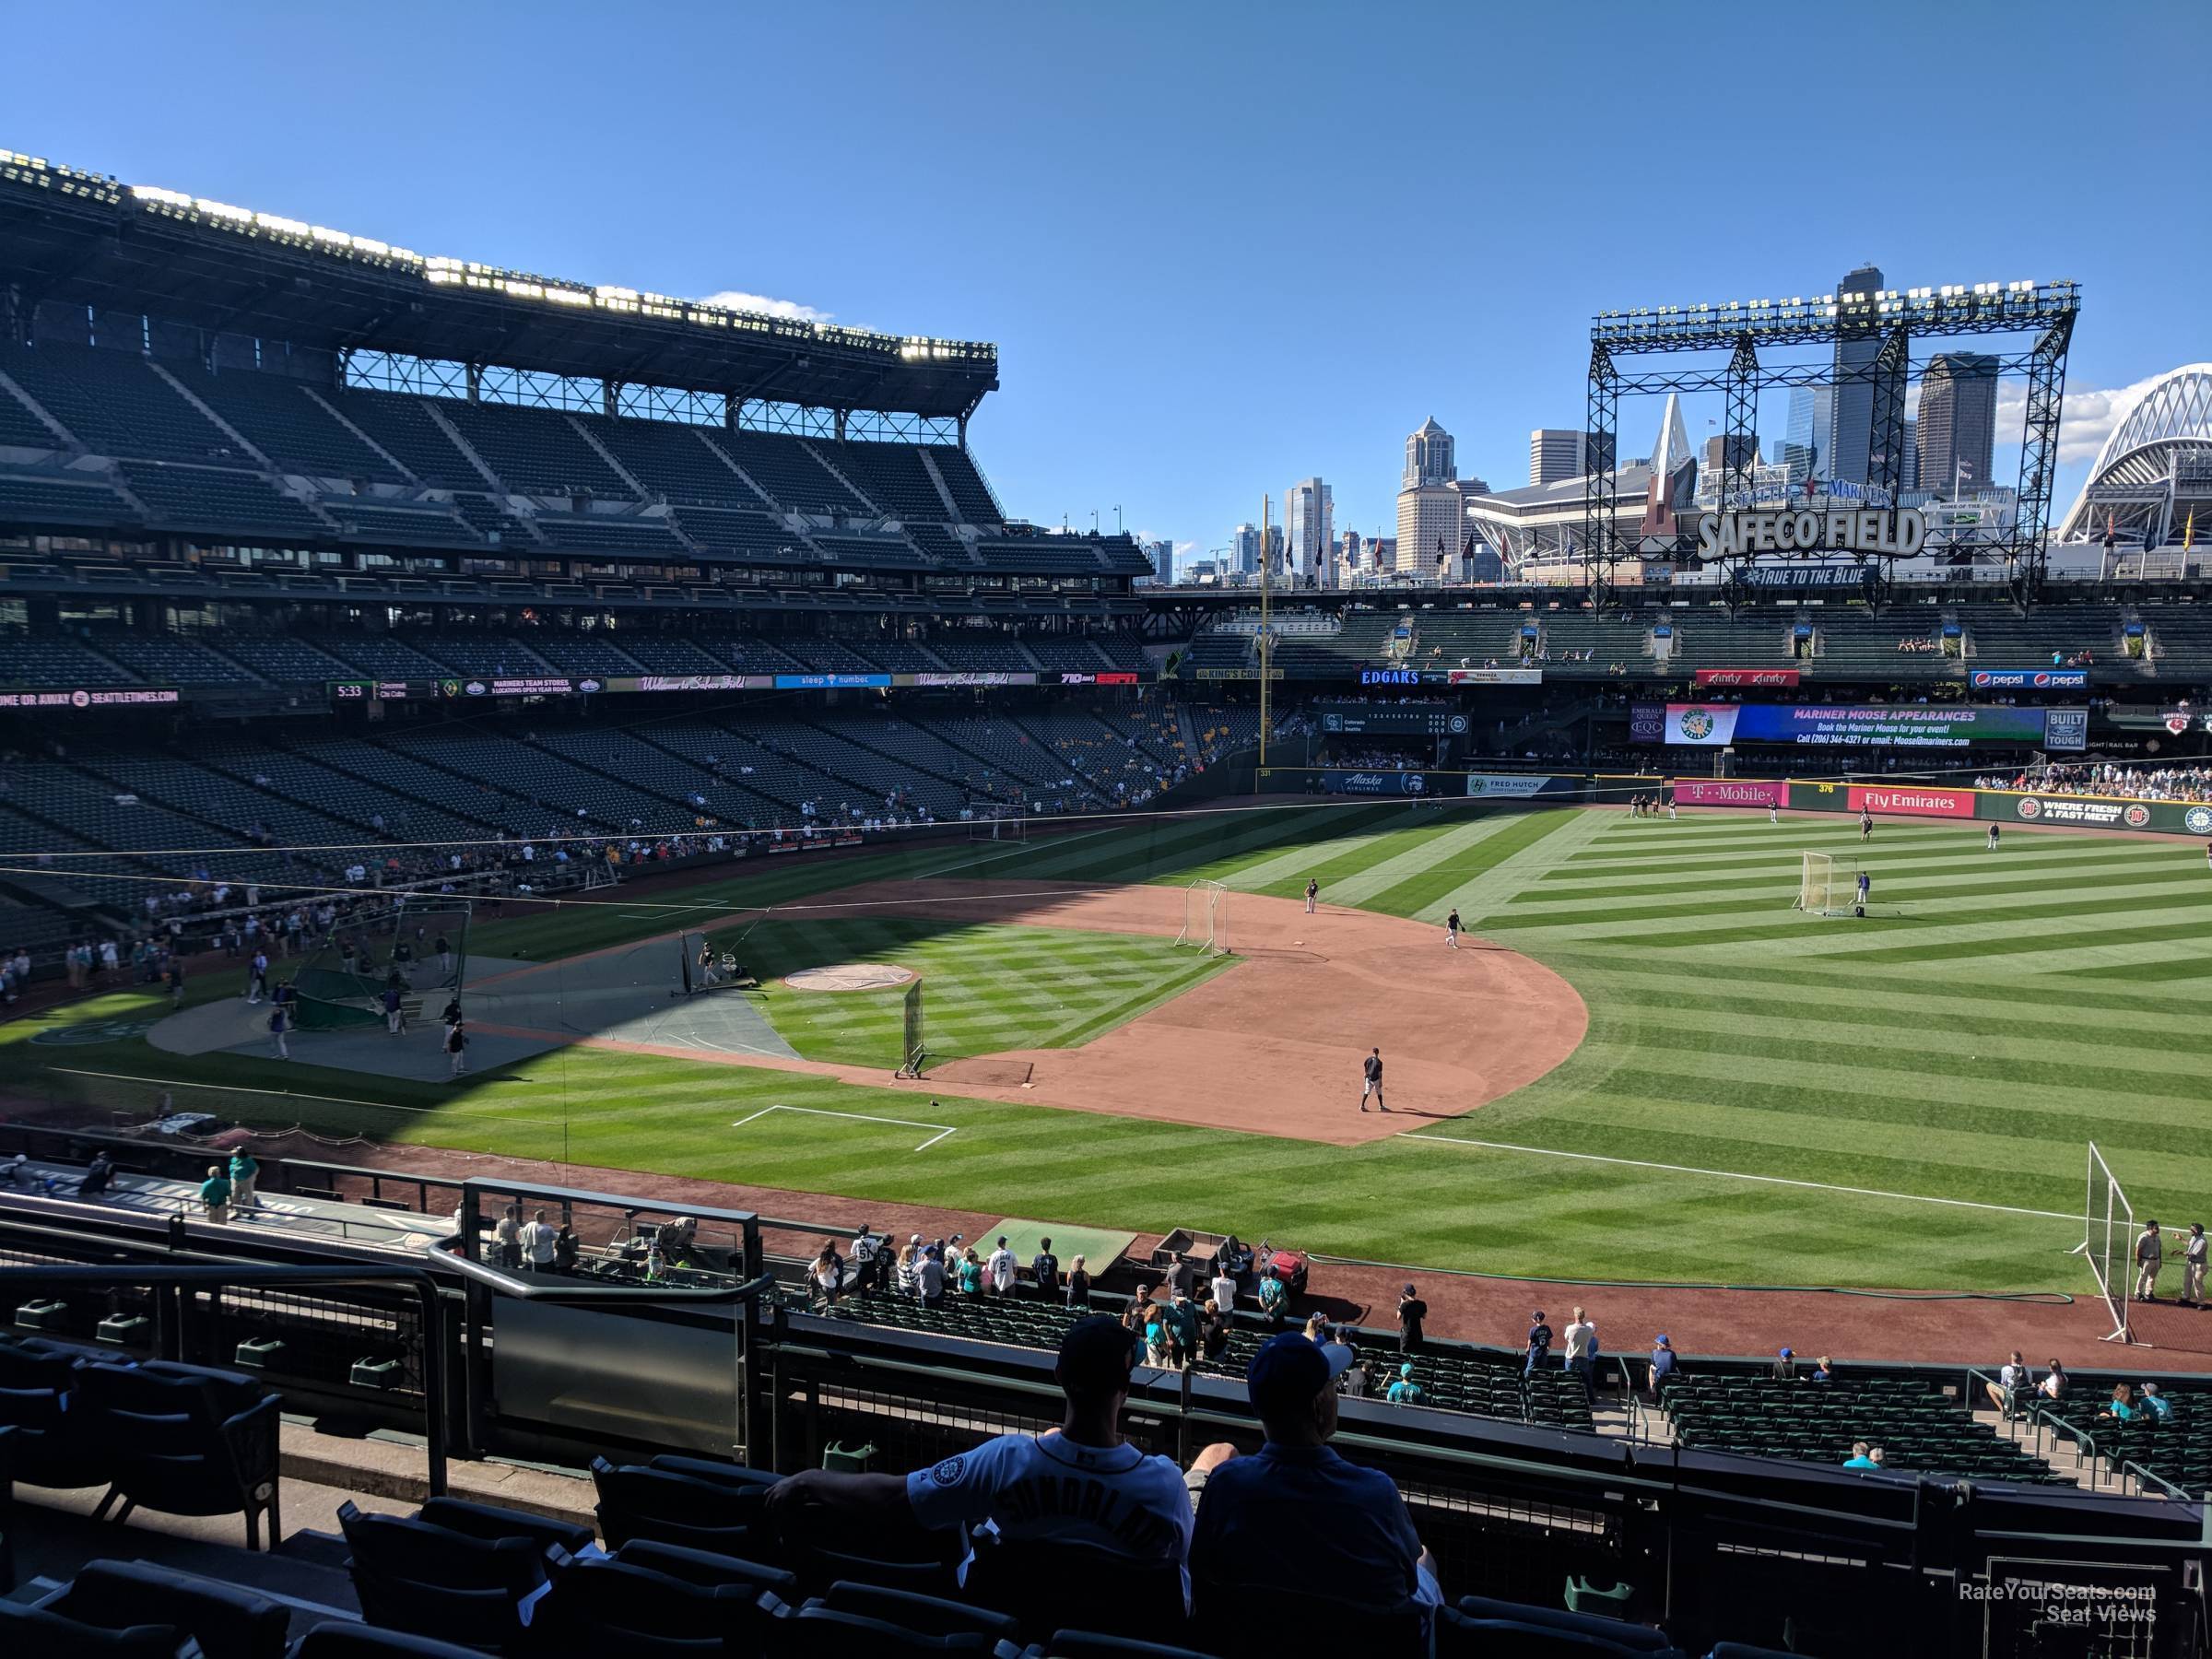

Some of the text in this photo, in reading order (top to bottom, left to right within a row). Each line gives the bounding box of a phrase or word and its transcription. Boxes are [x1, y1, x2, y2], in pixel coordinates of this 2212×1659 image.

[1726, 479, 1894, 508] SEATTLE MARINERS
[1698, 509, 1925, 560] SAFECO FIELD
[1761, 568, 1865, 584] TRUE TO THE BLUE
[957, 673, 984, 685] Safeco
[985, 673, 1008, 685] Field
[1062, 674, 1082, 683] 710
[1096, 674, 1137, 683] ESPN
[1209, 670, 1271, 678] KING'S COUT
[1709, 673, 1742, 685] xfinity
[1752, 673, 1786, 685] xfinity
[682, 680, 688, 689] to
[691, 676, 720, 689] Safeco
[721, 676, 746, 688] Field
[802, 676, 824, 686] sleep
[1993, 675, 2023, 686] pepsi
[2052, 675, 2083, 686] pepsi
[338, 686, 361, 697] 5:33
[20, 694, 37, 706] OR
[37, 693, 71, 705] AWAY
[1794, 710, 1976, 722] MARINER MOOSE APPEARANCES
[2050, 714, 2083, 724] BUILT
[1818, 723, 1950, 735] Book the Mariner Moose for your event!
[1797, 734, 1811, 743] Call
[1811, 734, 1830, 744] (206)
[1830, 735, 1862, 744] 346-4321
[1871, 735, 1892, 745] email:
[1894, 735, 1970, 746] Moose@mariners.com
[2049, 736, 2081, 745] TOUGH
[1345, 773, 1382, 785] Alaska
[1818, 784, 1834, 793] 376
[1865, 793, 1955, 808] Fly Emirates
[2043, 801, 2084, 811] WHERE
[2085, 804, 2123, 814] FRESH
[2055, 811, 2084, 819] FAST
[2085, 812, 2120, 822] MEET
[859, 1249, 871, 1260] 51
[1000, 1261, 1006, 1272] 2
